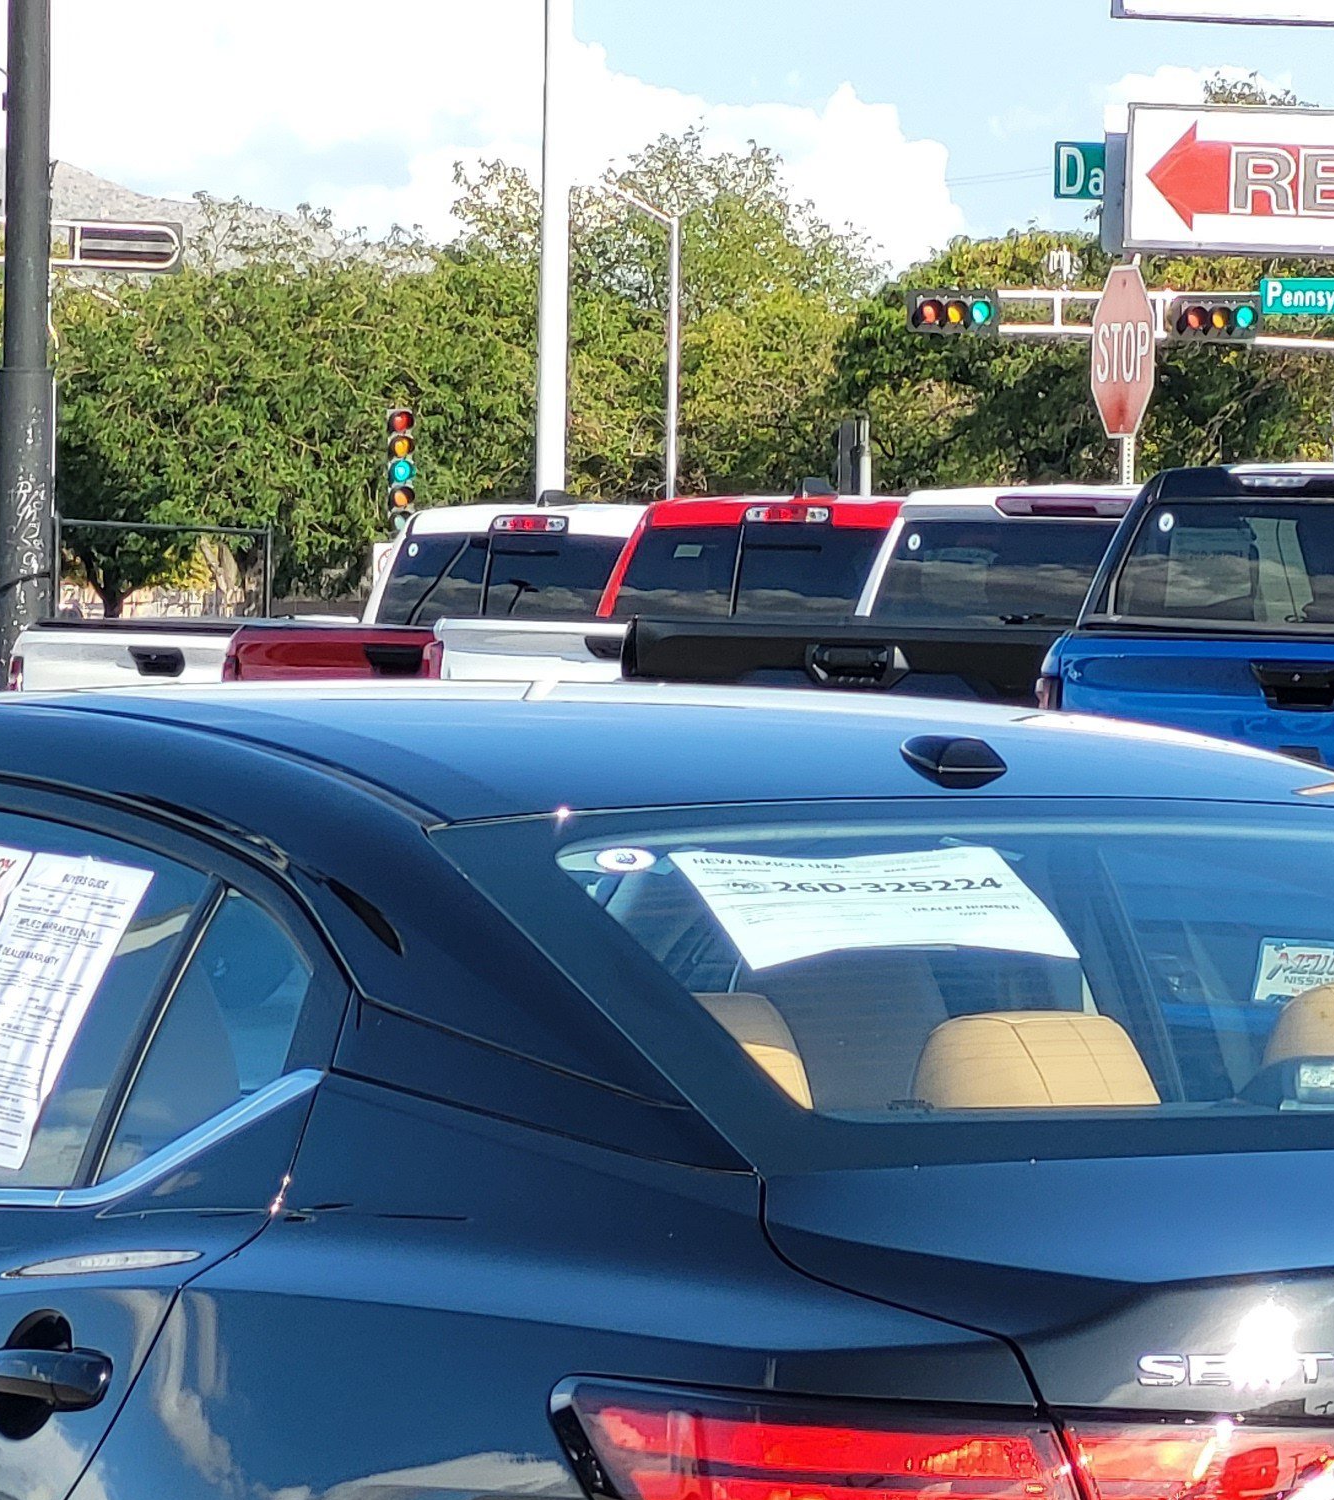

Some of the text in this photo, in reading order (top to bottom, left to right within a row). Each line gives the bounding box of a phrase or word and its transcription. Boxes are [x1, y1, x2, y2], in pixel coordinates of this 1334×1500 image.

[1059, 146, 1105, 197] Da
[1096, 321, 1150, 384] STOP
[737, 859, 805, 868] MEXICO
[771, 877, 1003, 893] 26D-325224
